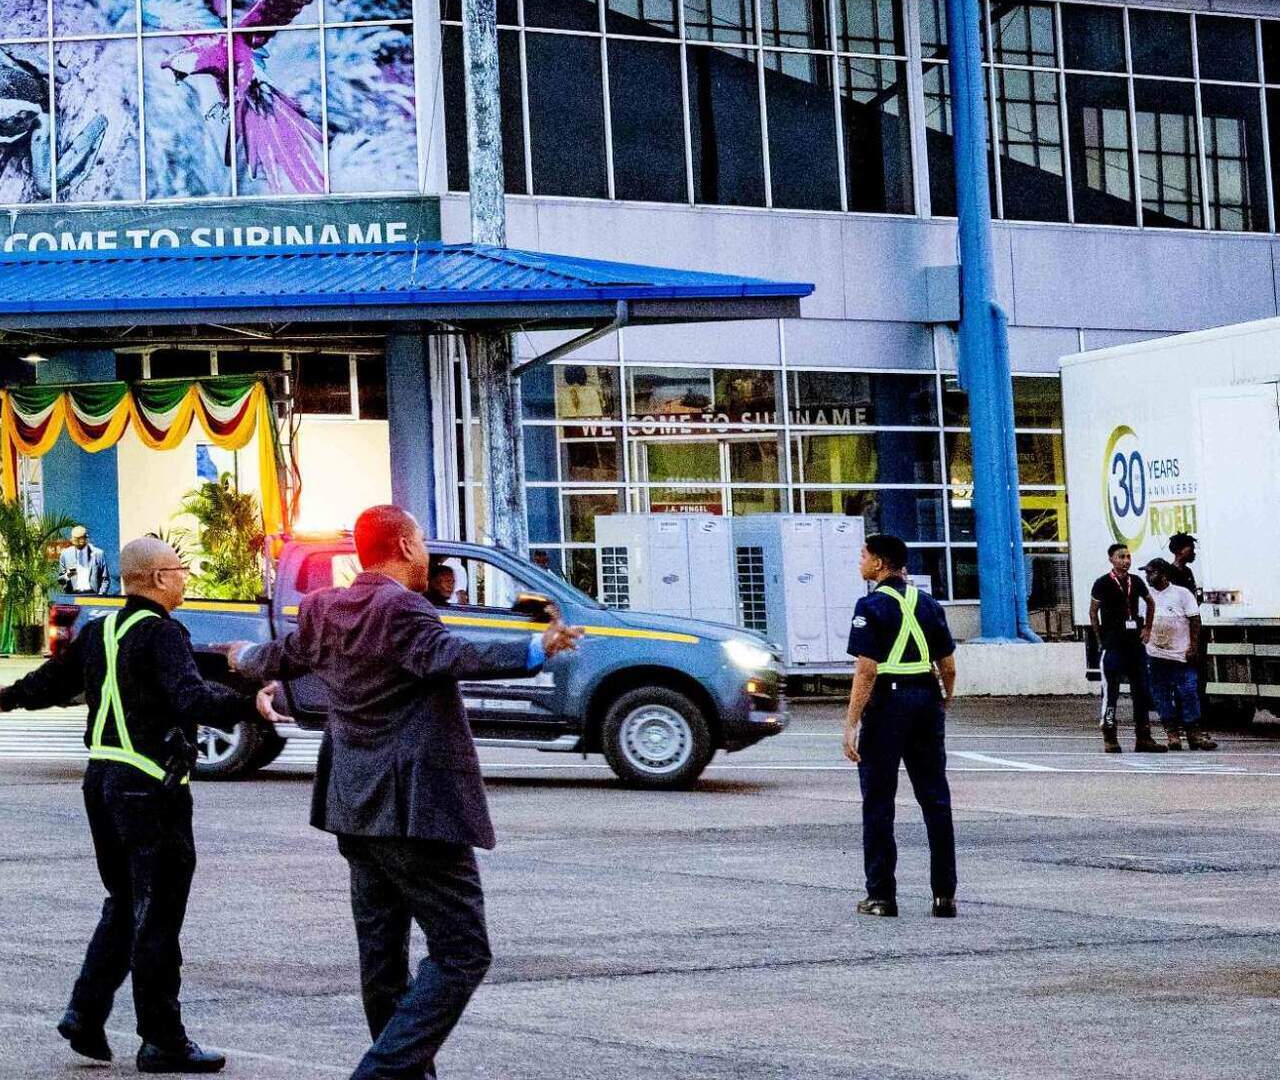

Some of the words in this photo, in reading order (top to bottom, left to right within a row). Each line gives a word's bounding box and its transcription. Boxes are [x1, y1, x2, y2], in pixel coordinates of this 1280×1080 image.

[125, 228, 180, 249] TO
[581, 414, 691, 436] WECOME
[702, 413, 730, 433] TO
[742, 407, 868, 432] SUINAME
[1112, 451, 1145, 517] 30
[1147, 458, 1180, 479] YEARS
